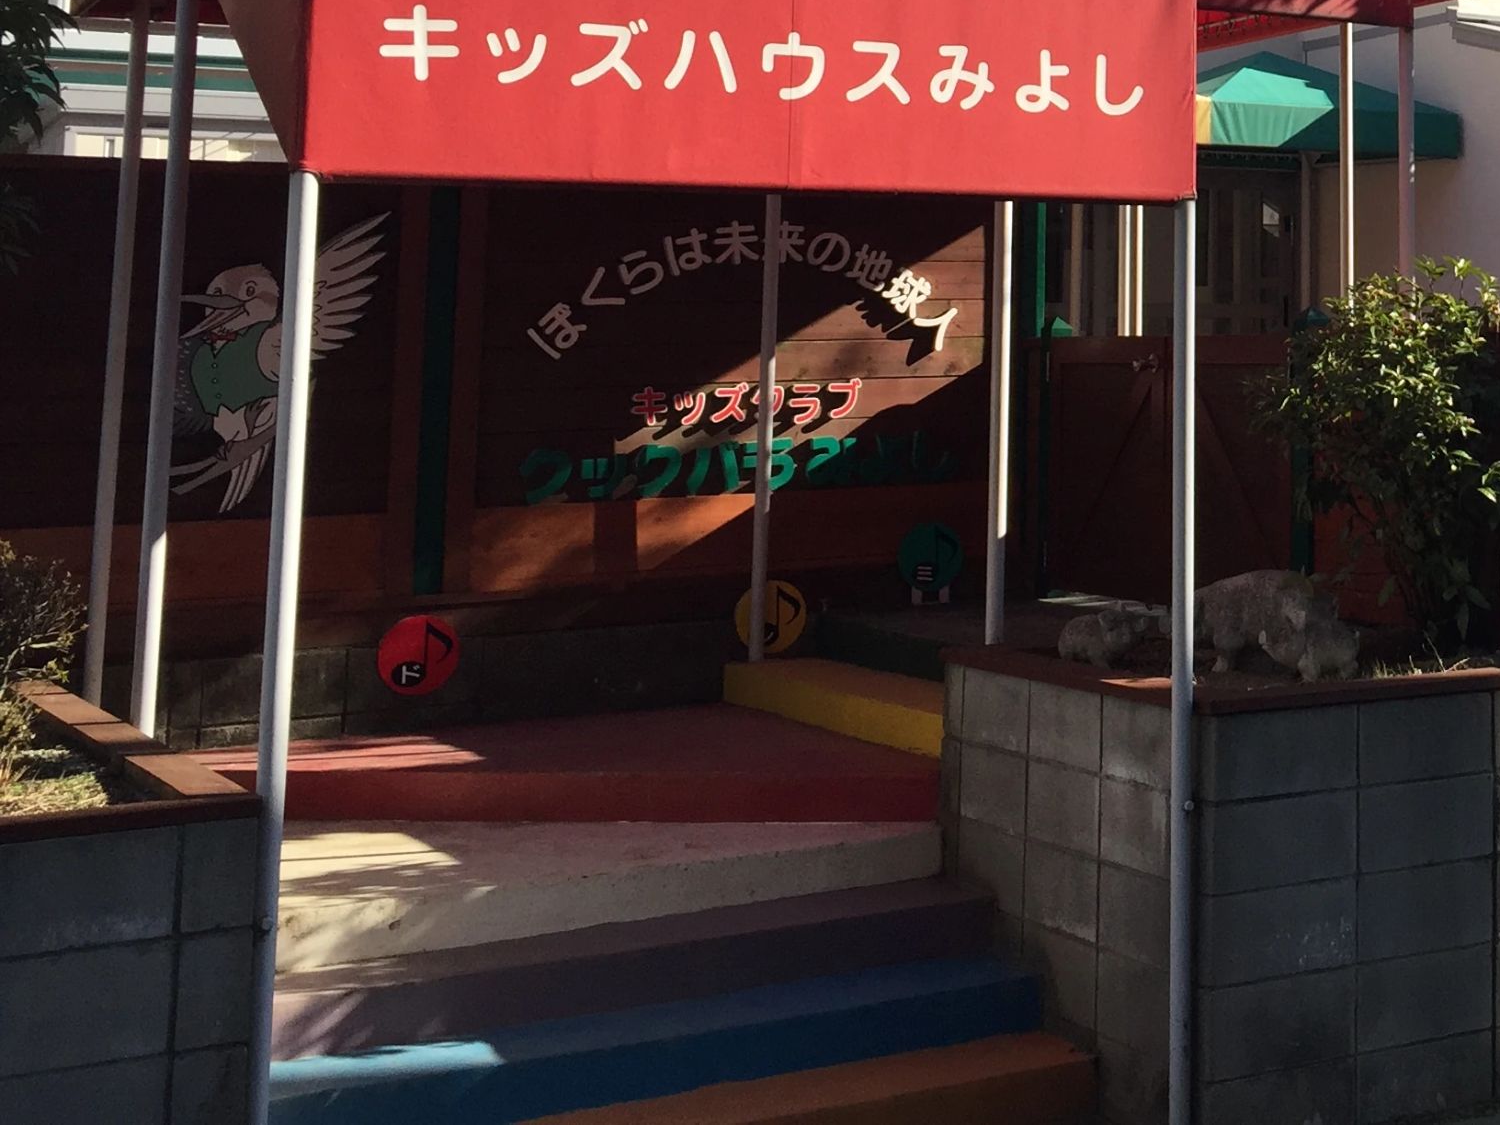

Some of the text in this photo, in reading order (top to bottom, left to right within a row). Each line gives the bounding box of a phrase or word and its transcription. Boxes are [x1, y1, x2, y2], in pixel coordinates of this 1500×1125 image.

[378, 3, 1144, 117] キッズハウスみよし
[526, 220, 959, 360] ぼくらは未来の地球人
[630, 377, 863, 427] キッズクラブ
